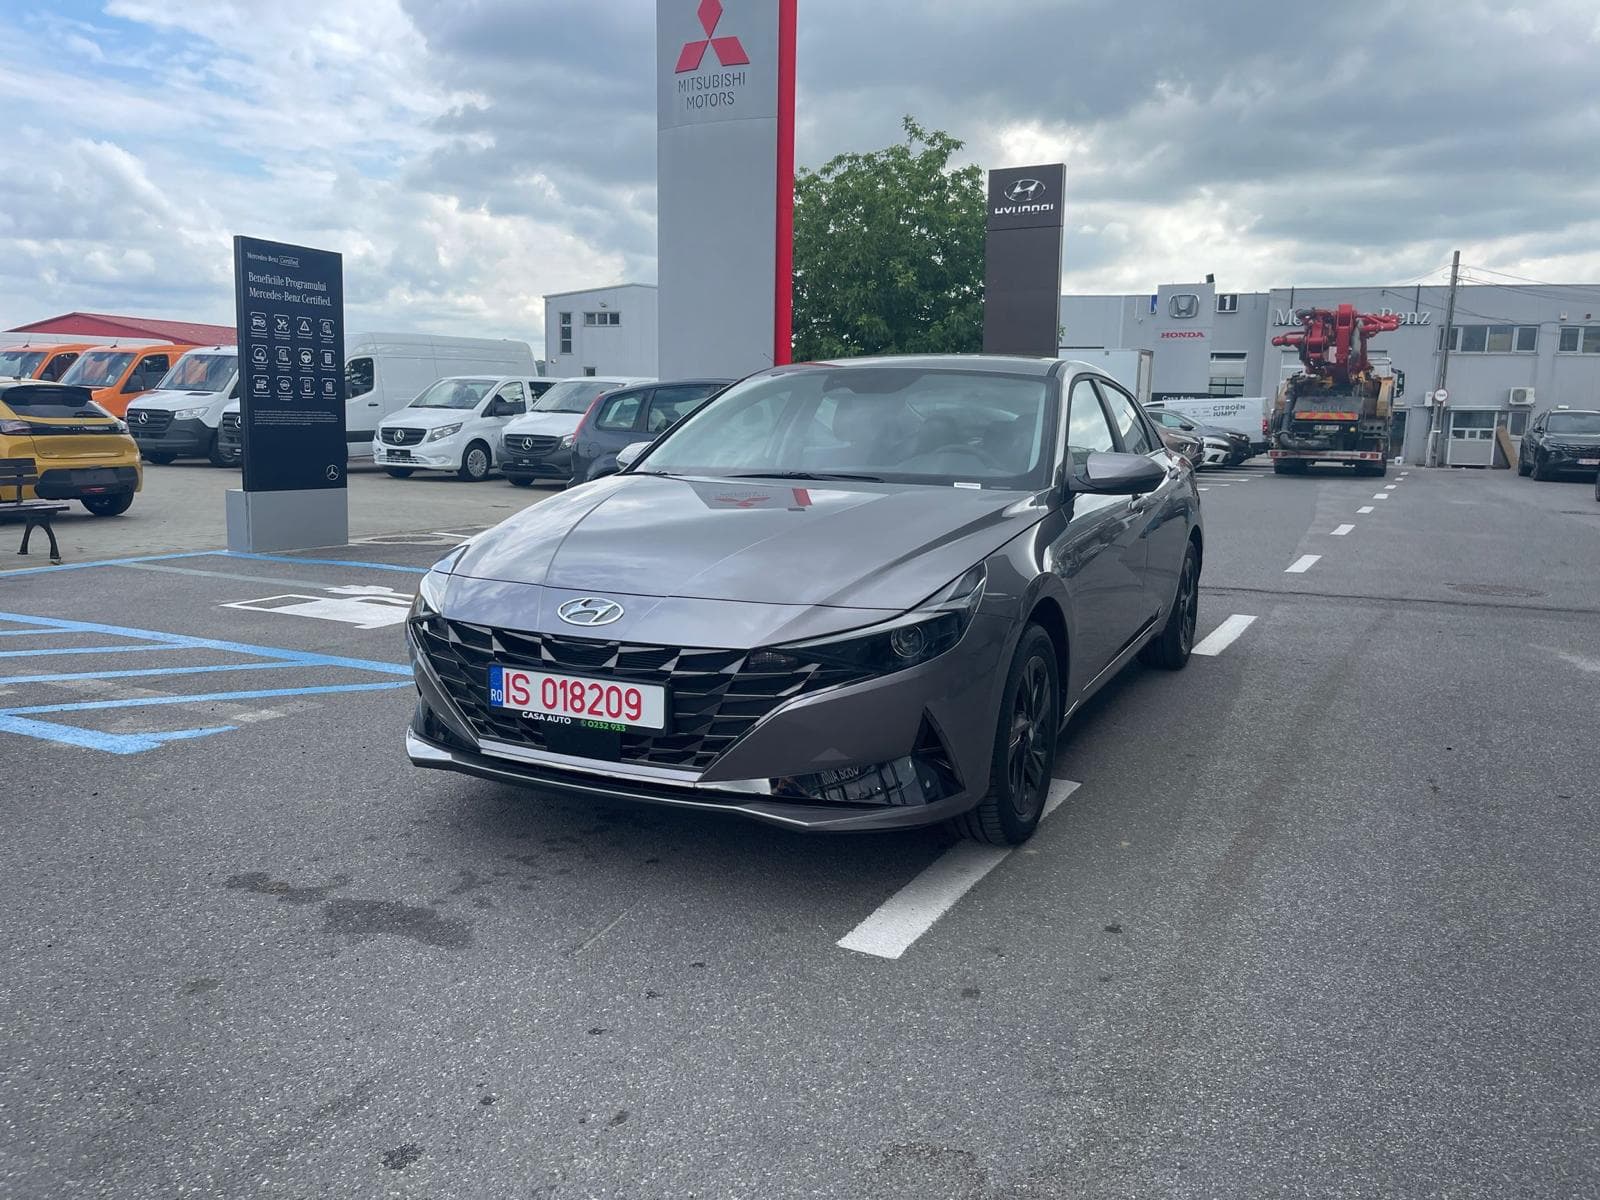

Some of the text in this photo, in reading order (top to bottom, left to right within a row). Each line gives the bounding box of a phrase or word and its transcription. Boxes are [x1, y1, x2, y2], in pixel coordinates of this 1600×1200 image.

[678, 72, 746, 93] MITSUBISHI
[686, 91, 735, 110] MOTORS
[248, 271, 327, 292] Beneficiile Programului
[249, 287, 301, 303] Mercedes-Benz
[1161, 331, 1206, 339] HONDA
[490, 688, 503, 702] RO
[505, 672, 642, 722] IS 018209
[522, 711, 572, 725] CASA AUTO
[587, 720, 609, 730] 0232
